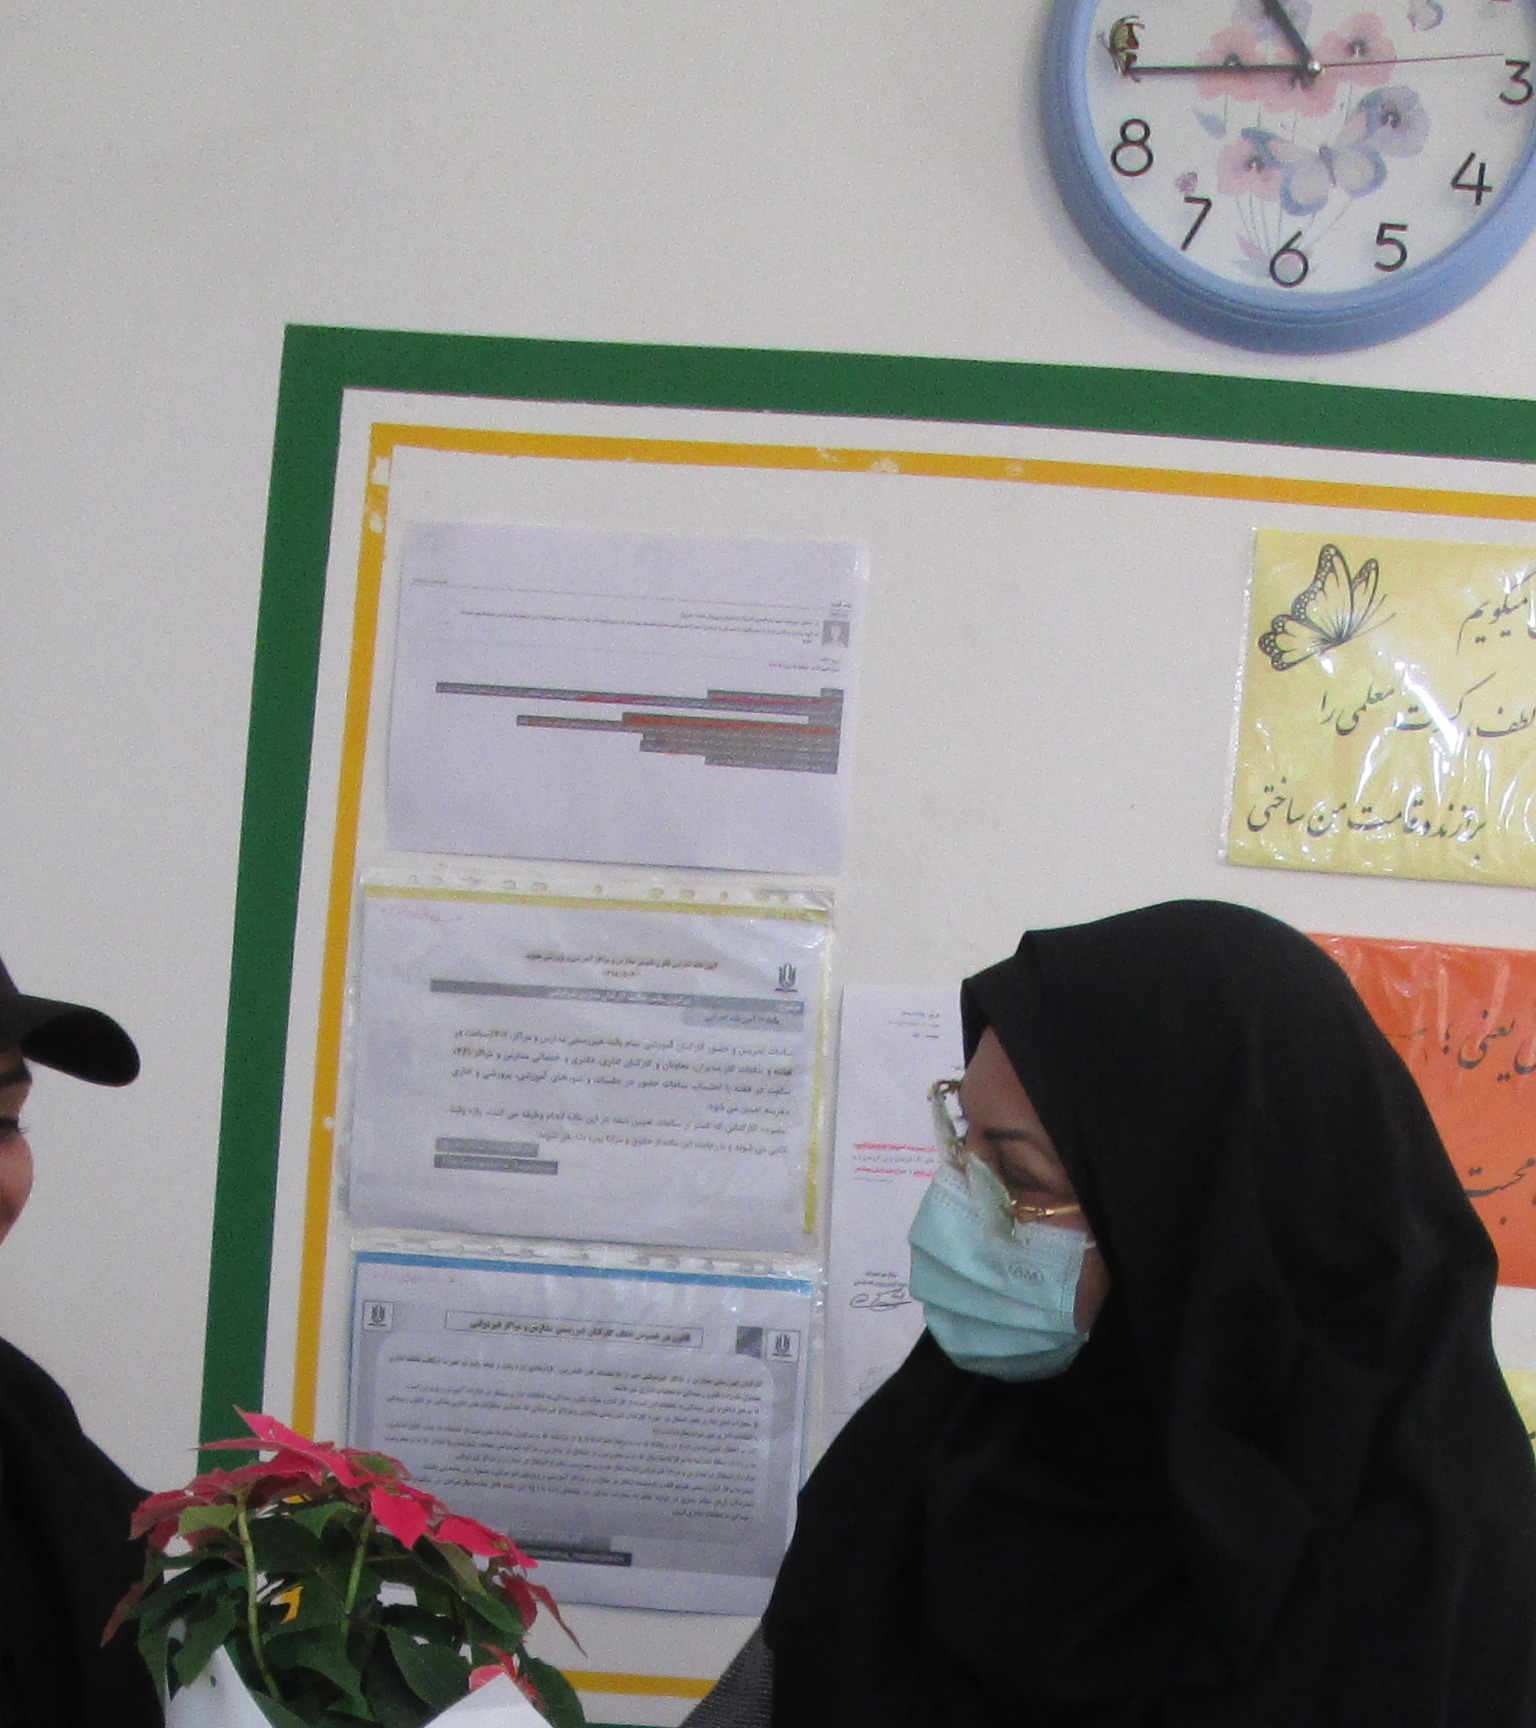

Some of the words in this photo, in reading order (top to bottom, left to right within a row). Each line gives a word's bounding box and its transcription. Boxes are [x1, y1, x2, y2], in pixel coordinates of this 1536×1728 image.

[1499, 60, 1533, 104] 3
[1111, 118, 1154, 177] 8
[1451, 153, 1493, 206] 4
[1181, 196, 1212, 251] 7
[1374, 223, 1407, 272] 5
[1269, 231, 1309, 287] 6
[1247, 777, 1305, 832] ساختی
[1307, 802, 1348, 837] من
